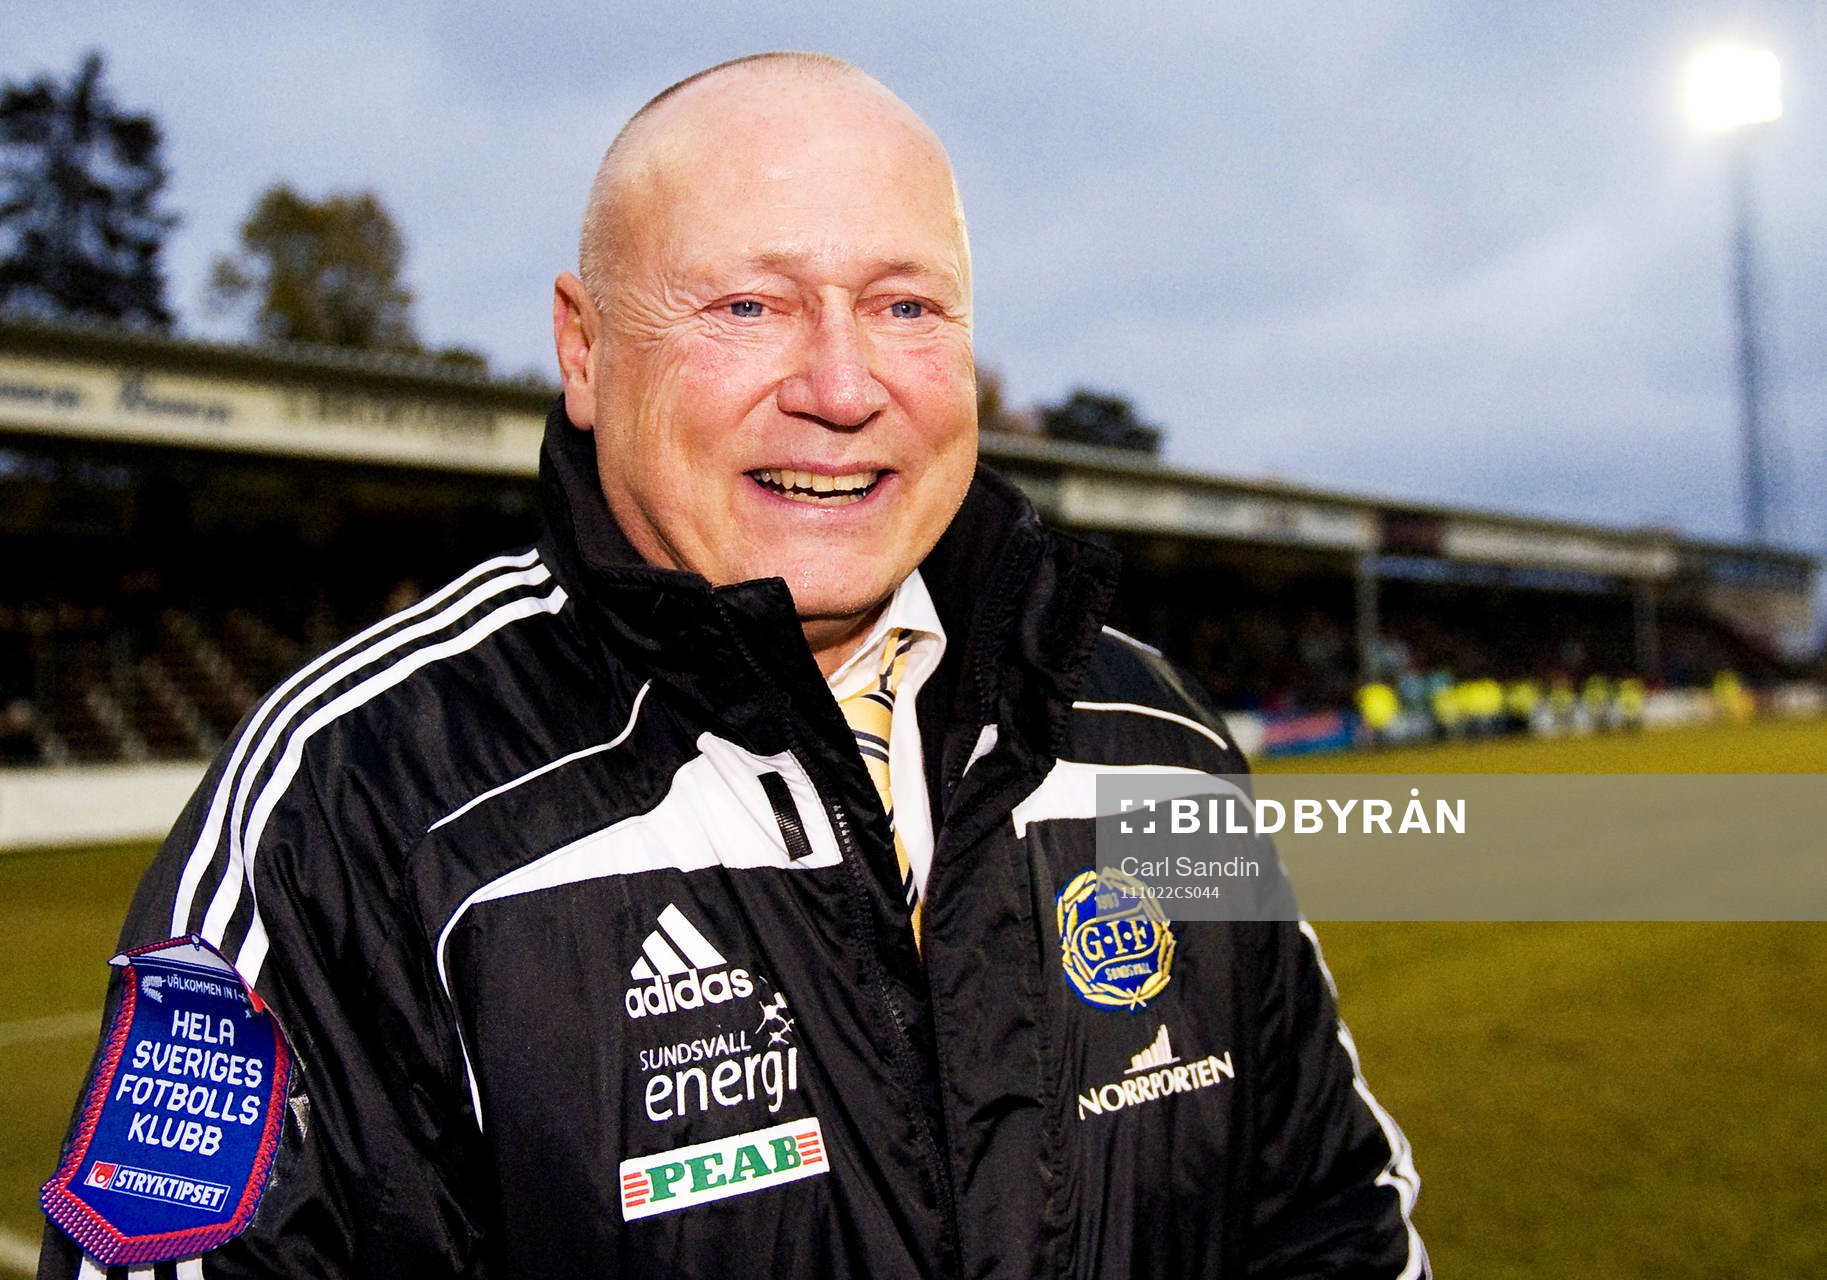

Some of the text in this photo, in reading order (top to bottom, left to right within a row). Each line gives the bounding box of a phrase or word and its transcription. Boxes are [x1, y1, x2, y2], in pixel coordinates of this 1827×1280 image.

[167, 974, 222, 996] VÄLKOMMEN
[223, 986, 233, 999] IN
[625, 968, 753, 1018] adidas
[172, 1010, 235, 1046] HELA
[640, 1031, 751, 1071] SUNDSVALL
[132, 1041, 263, 1088] SVERIGES
[1078, 1051, 1235, 1120] NORRPORTEN
[116, 1075, 260, 1126] FOTBOLLS
[128, 1112, 223, 1157] KLUBB
[115, 1169, 226, 1208] STRYKTIPSET
[646, 1135, 802, 1202] PEAB
